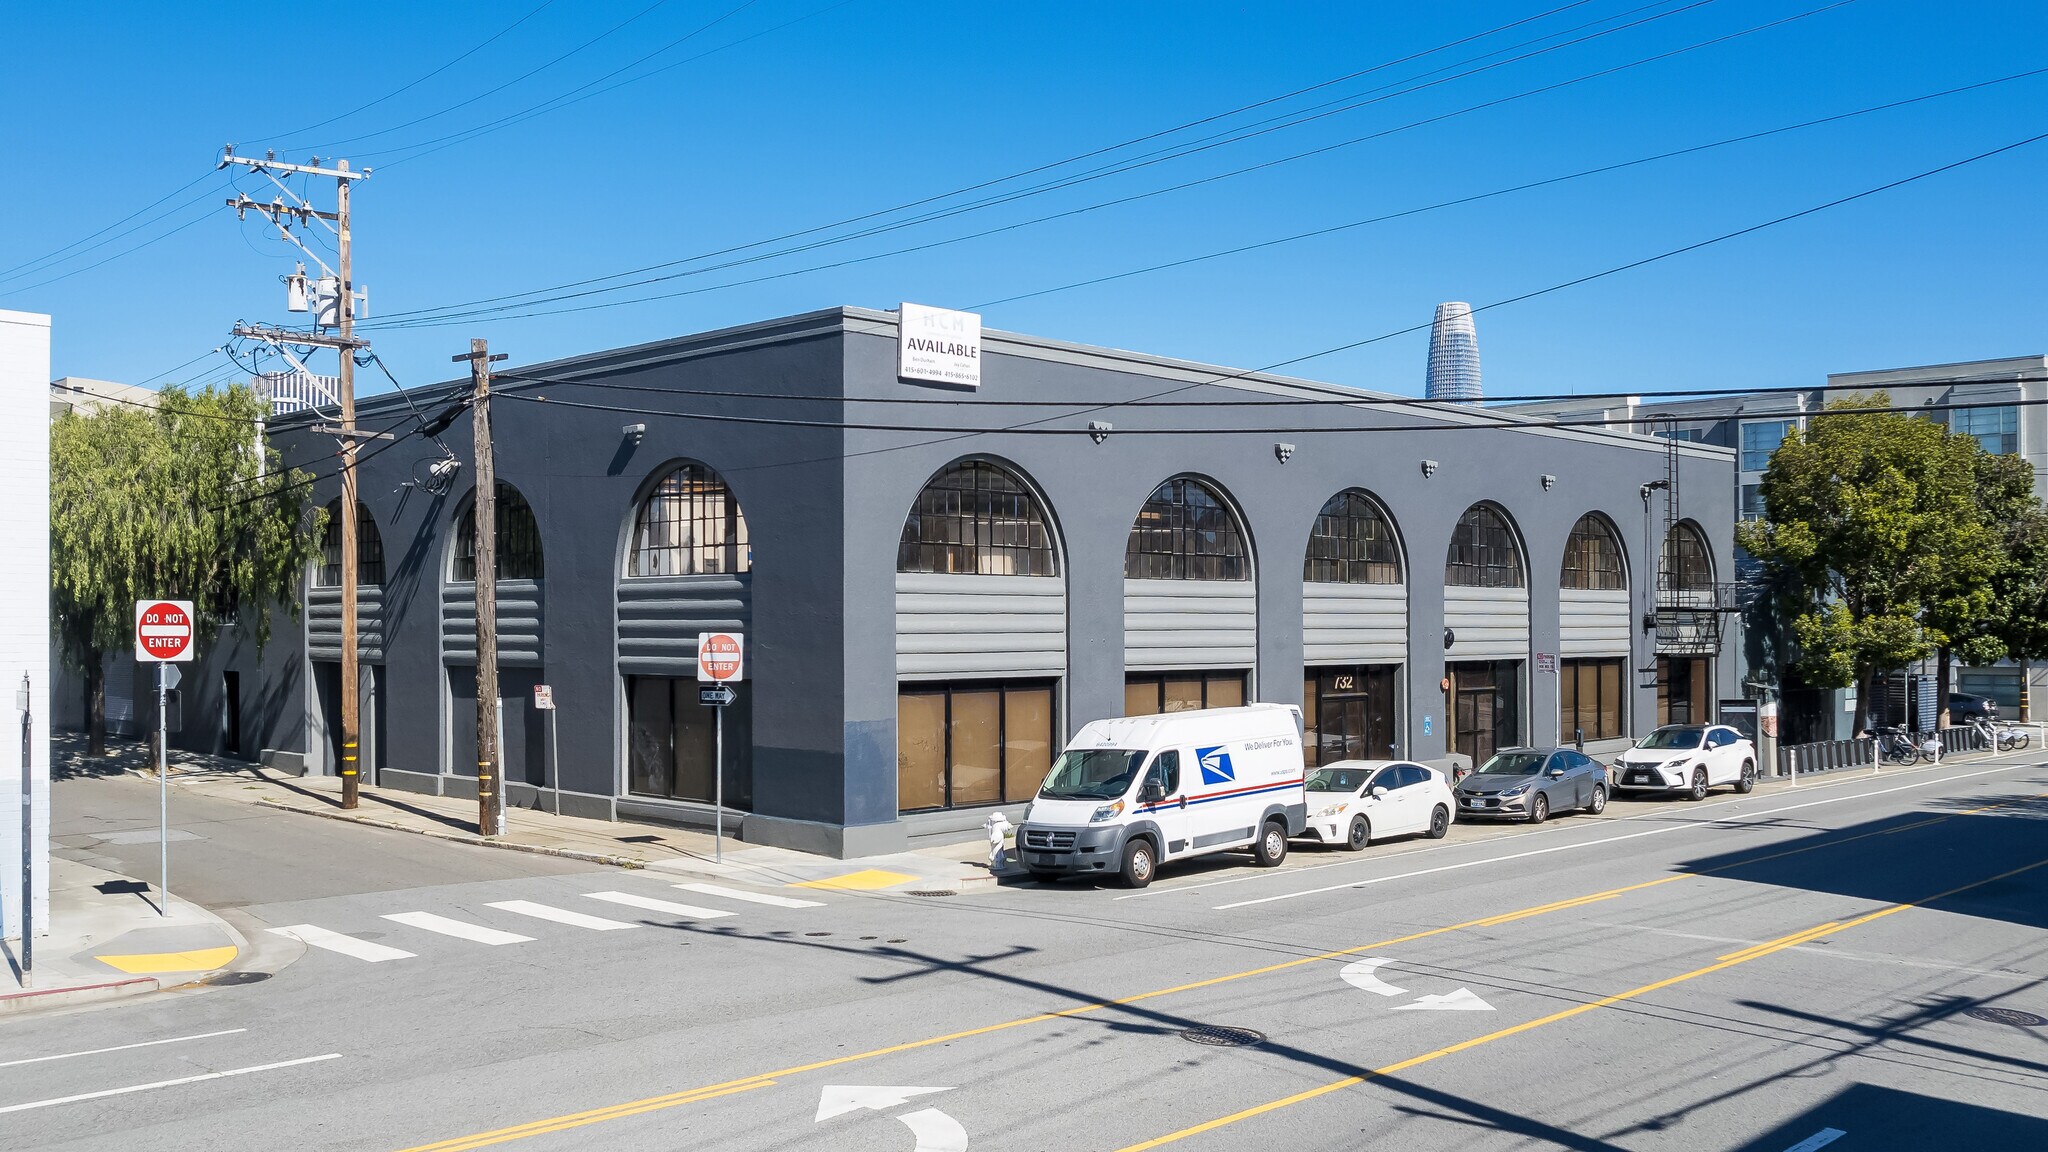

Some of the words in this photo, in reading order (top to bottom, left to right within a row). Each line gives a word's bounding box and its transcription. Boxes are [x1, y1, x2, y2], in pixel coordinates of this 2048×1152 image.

[907, 337, 977, 359] AVAILABLE
[146, 613, 159, 624] DO
[165, 613, 184, 624] NOT
[148, 638, 181, 648] ENTER
[706, 643, 717, 651] DO
[721, 643, 736, 651] NOT
[708, 662, 734, 671] ENTER
[1334, 675, 1353, 689] 732
[702, 691, 714, 700] ONE
[715, 691, 726, 700] WAY
[1244, 742, 1254, 751] We
[1254, 740, 1273, 750] Deliver
[1273, 739, 1282, 747] For
